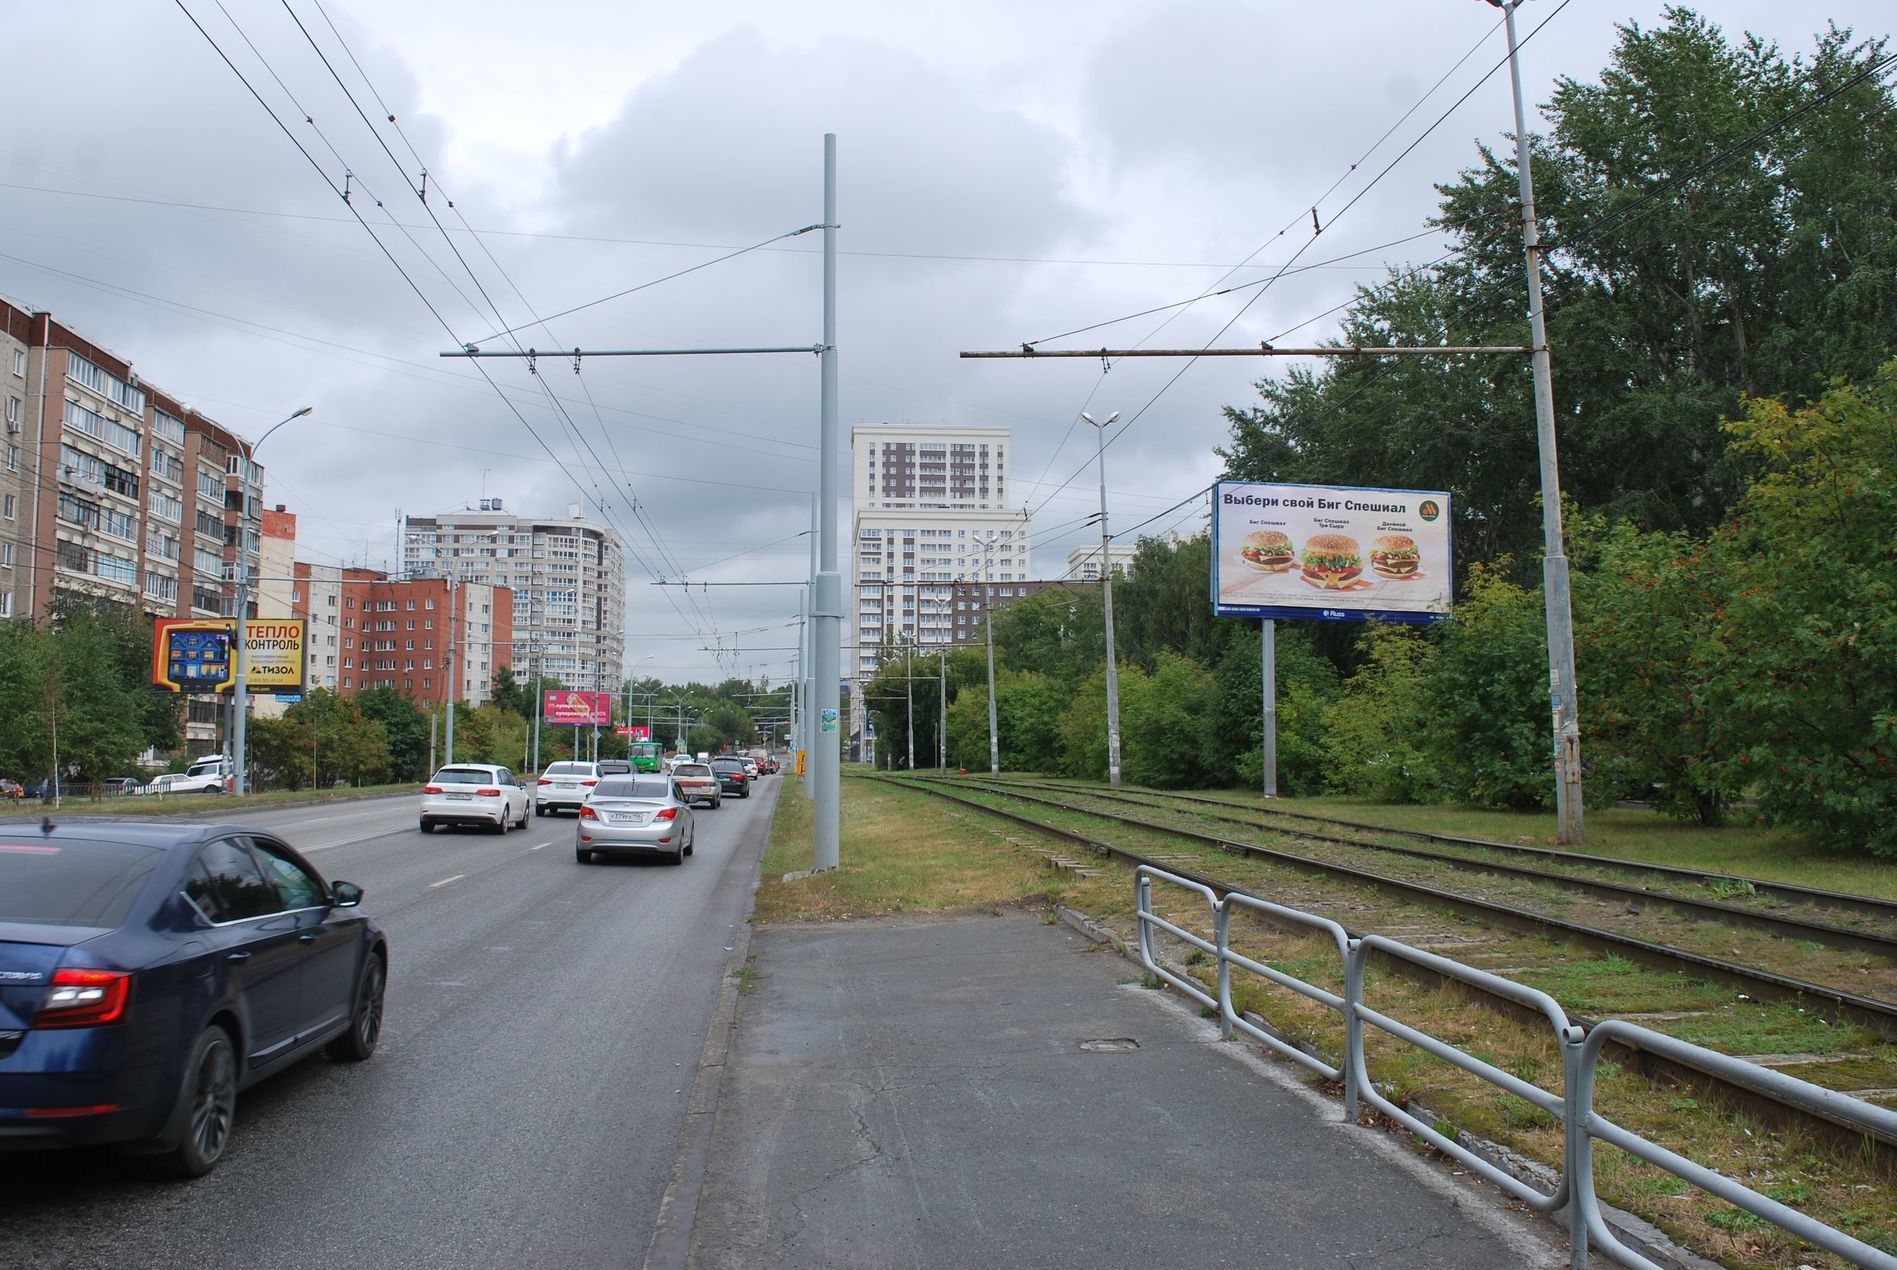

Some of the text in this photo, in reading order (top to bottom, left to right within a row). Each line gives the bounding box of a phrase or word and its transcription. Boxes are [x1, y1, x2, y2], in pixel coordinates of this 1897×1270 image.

[1223, 493, 1406, 514] Выбери свой Биг Спешиал
[246, 625, 300, 638] ТЕПЛО
[262, 666, 294, 674] ТИЗОЛ
